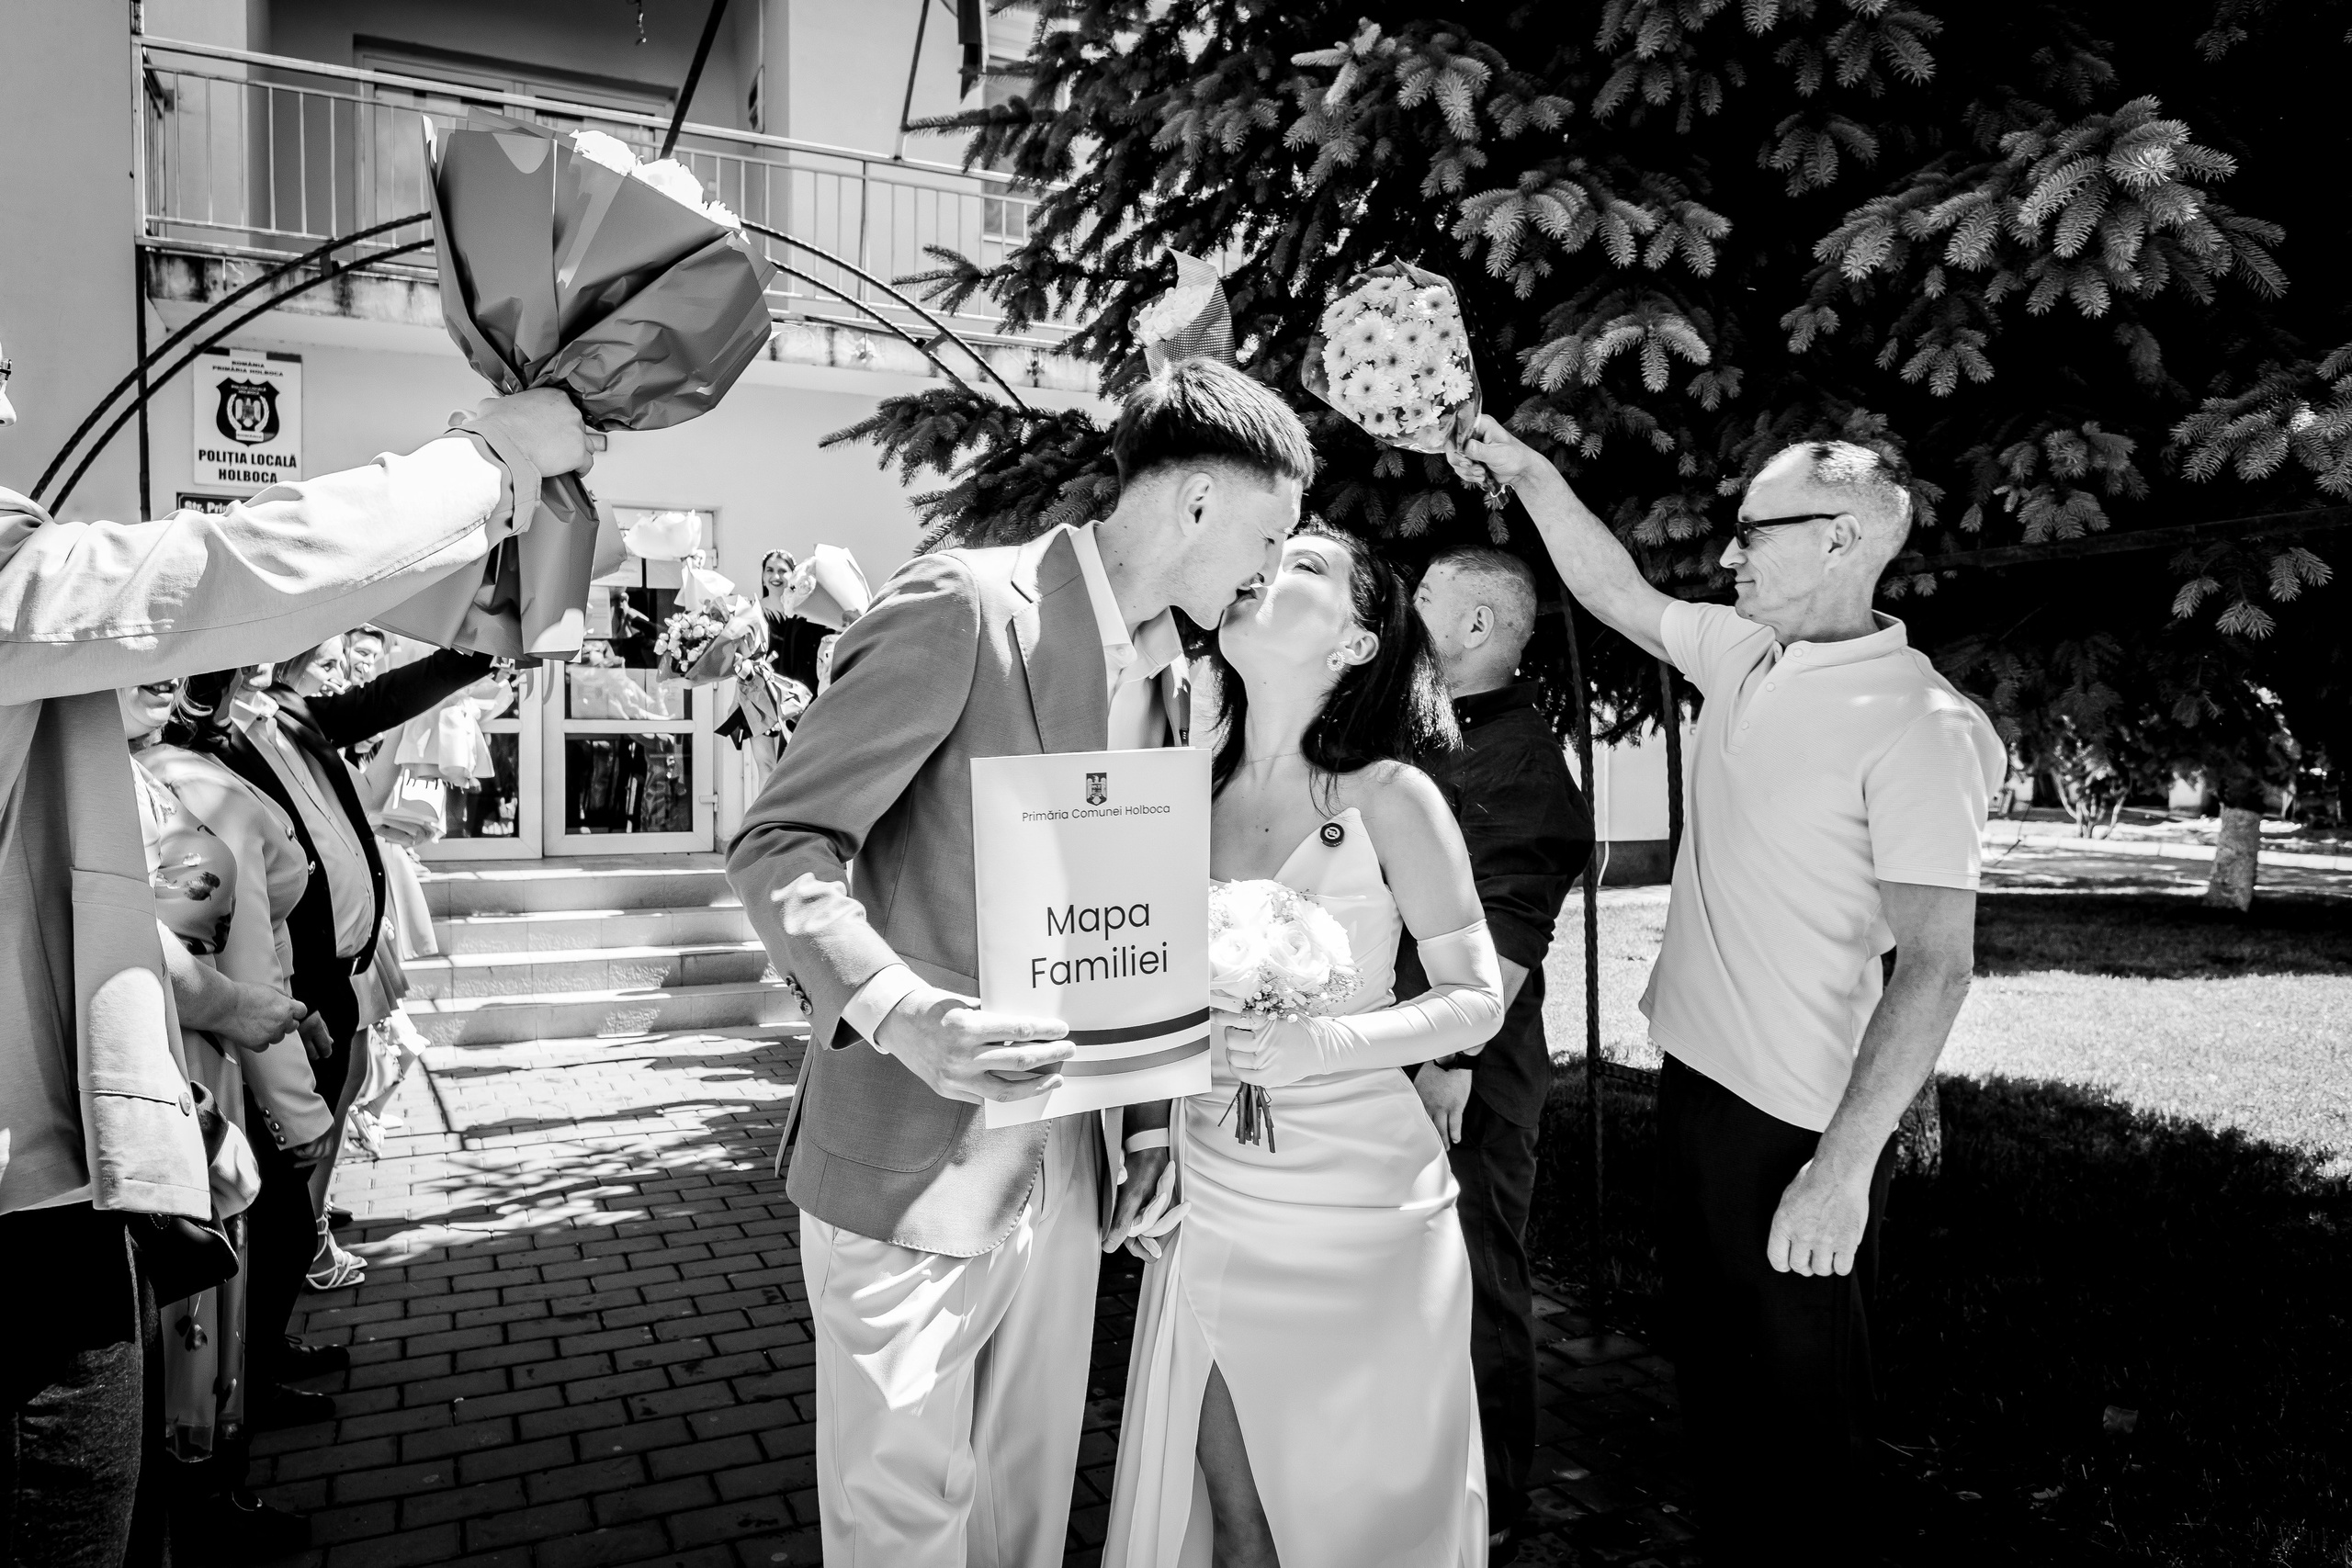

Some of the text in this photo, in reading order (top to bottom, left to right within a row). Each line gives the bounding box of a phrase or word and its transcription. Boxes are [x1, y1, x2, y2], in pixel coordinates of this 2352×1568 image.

[198, 449, 298, 468] POLIȚIA LOCALĂ
[219, 468, 277, 483] HOLBOCA
[185, 500, 205, 513] Str.
[1022, 804, 1170, 822] Primăria Comunei Holboca
[1046, 901, 1150, 941] Mapa
[1030, 941, 1169, 989] Familiei
